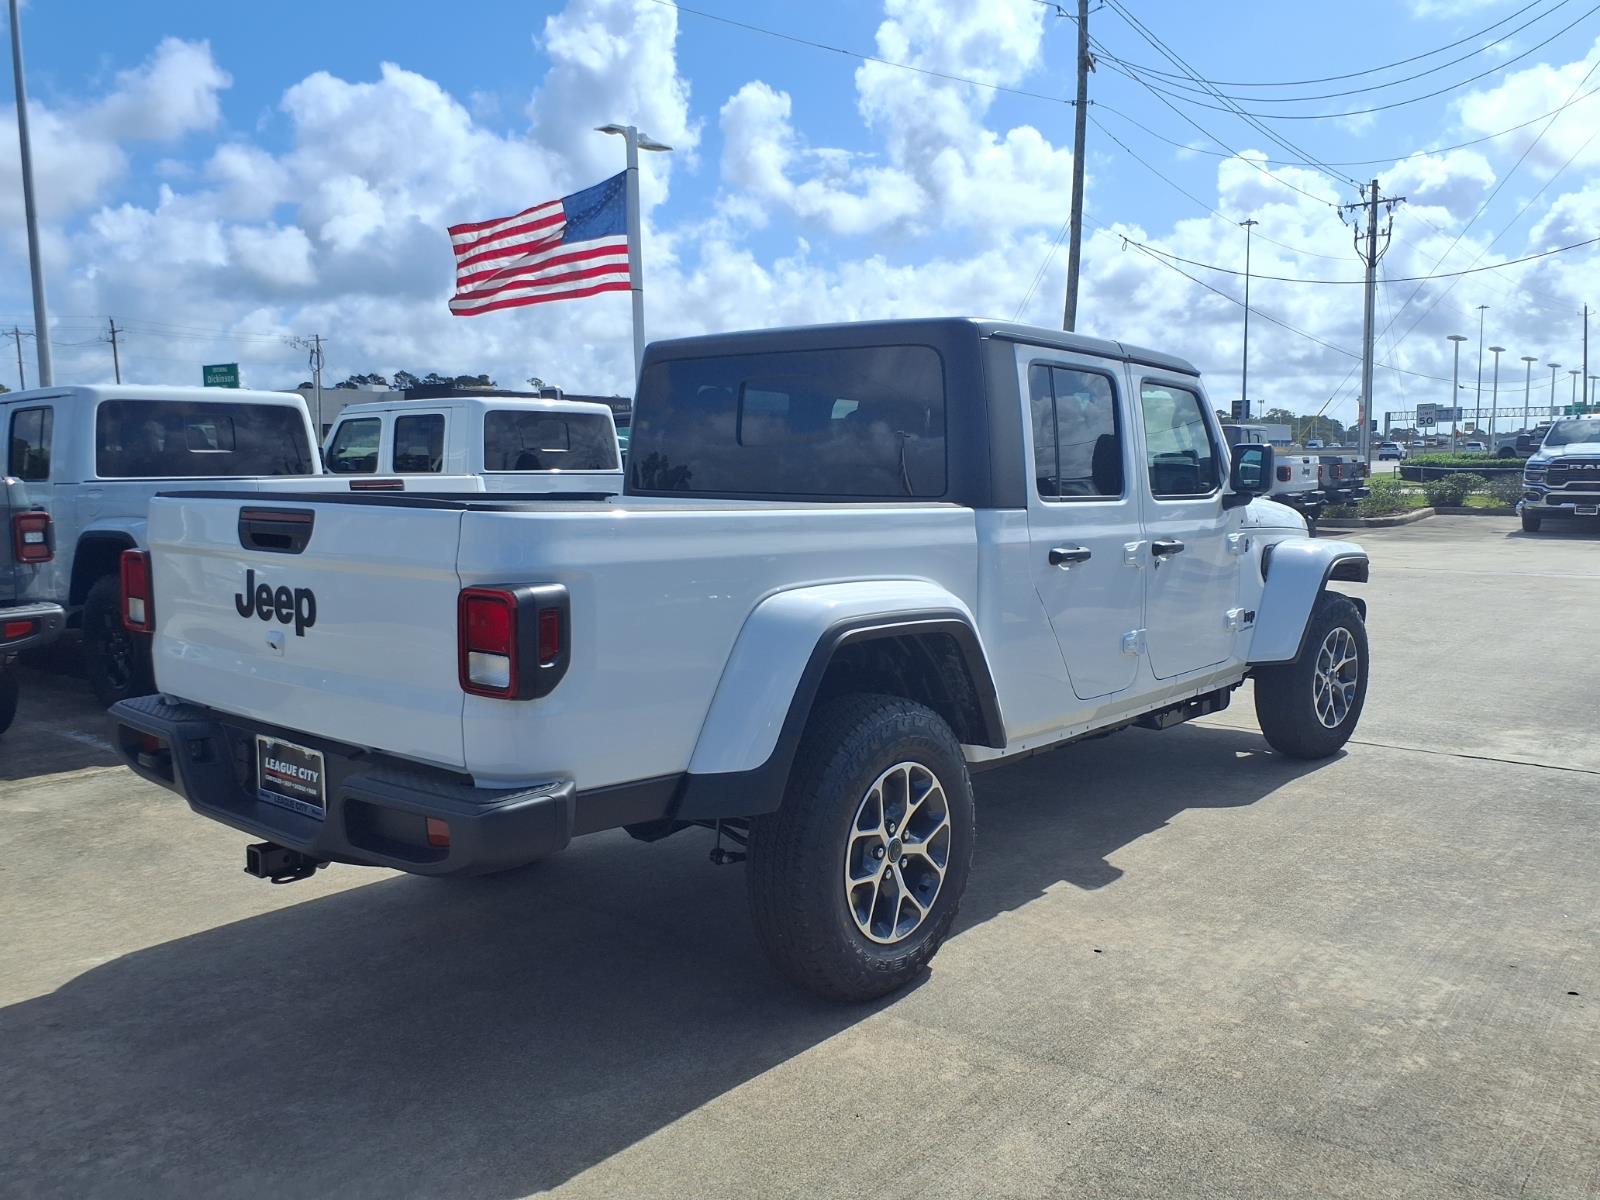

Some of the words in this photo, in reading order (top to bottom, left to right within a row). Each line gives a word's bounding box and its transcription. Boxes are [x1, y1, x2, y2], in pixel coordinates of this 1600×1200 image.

[207, 374, 235, 384] Dickinson
[1419, 416, 1434, 425] 50
[235, 568, 317, 637] Jeep
[264, 757, 298, 777] LEAGUE
[298, 767, 319, 783] CITY
